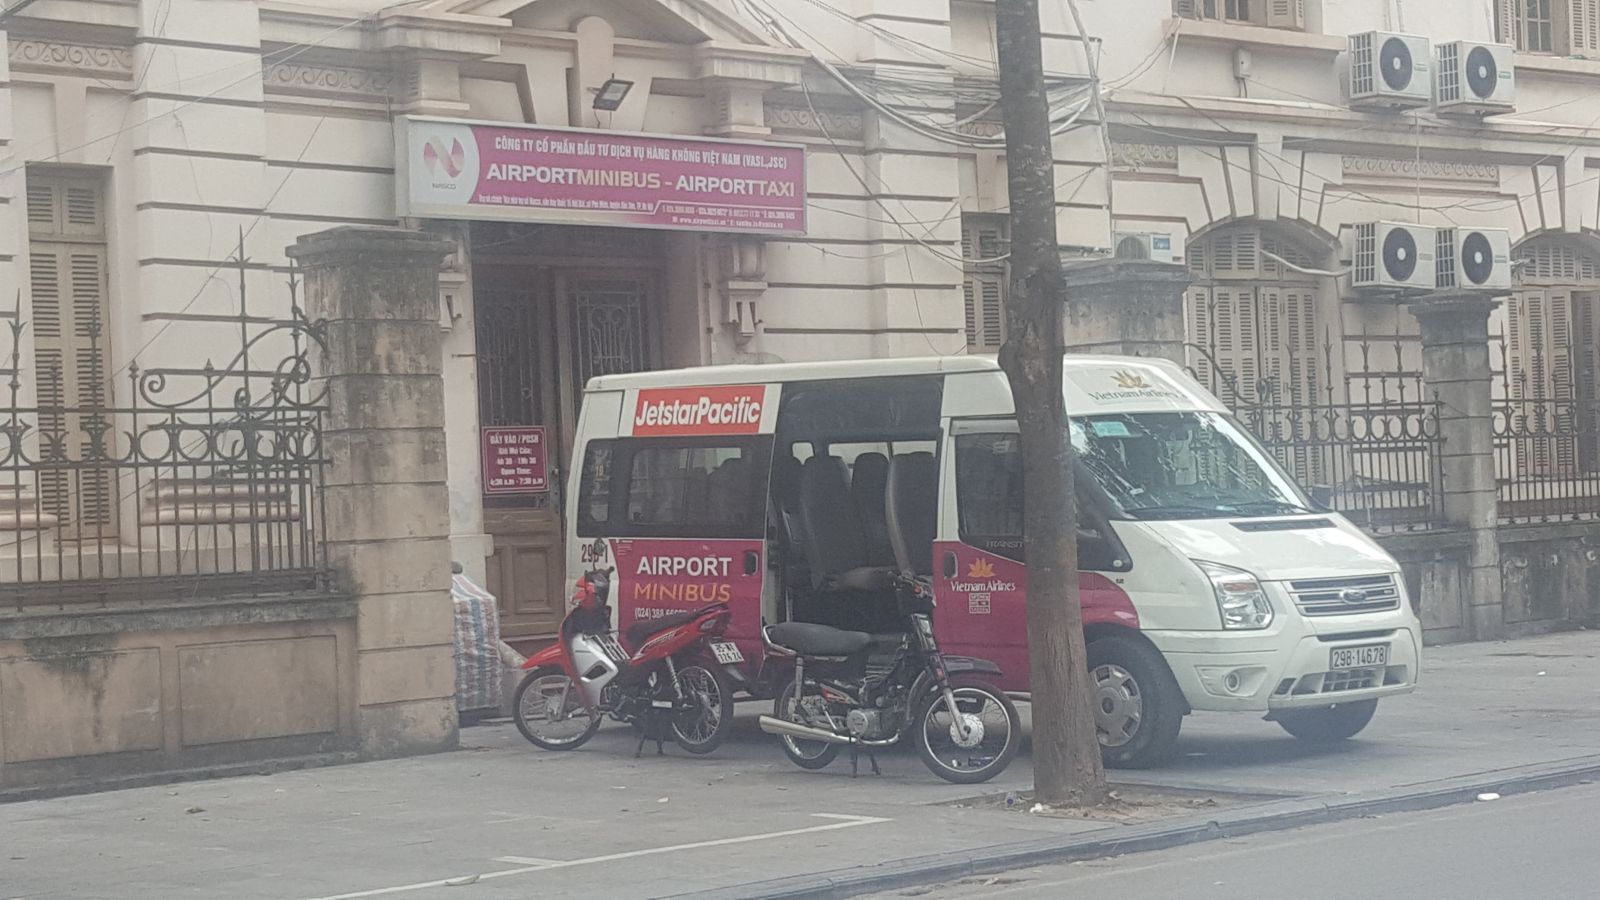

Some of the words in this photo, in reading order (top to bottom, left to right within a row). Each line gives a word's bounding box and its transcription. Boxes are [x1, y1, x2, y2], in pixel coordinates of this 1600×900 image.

[495, 135, 520, 151] CÔNG
[523, 139, 534, 152] TY
[633, 146, 645, 161] VỤ
[647, 145, 670, 161] HÀNG
[672, 147, 700, 163] KHÔNG
[702, 149, 720, 167] VIỆT
[722, 152, 741, 166] NAM
[636, 556, 733, 577] AIRPORT
[634, 582, 732, 602] MINIBUS
[950, 581, 986, 592] Vietnam
[986, 580, 1016, 592] Airlines
[634, 607, 651, 620] (024)
